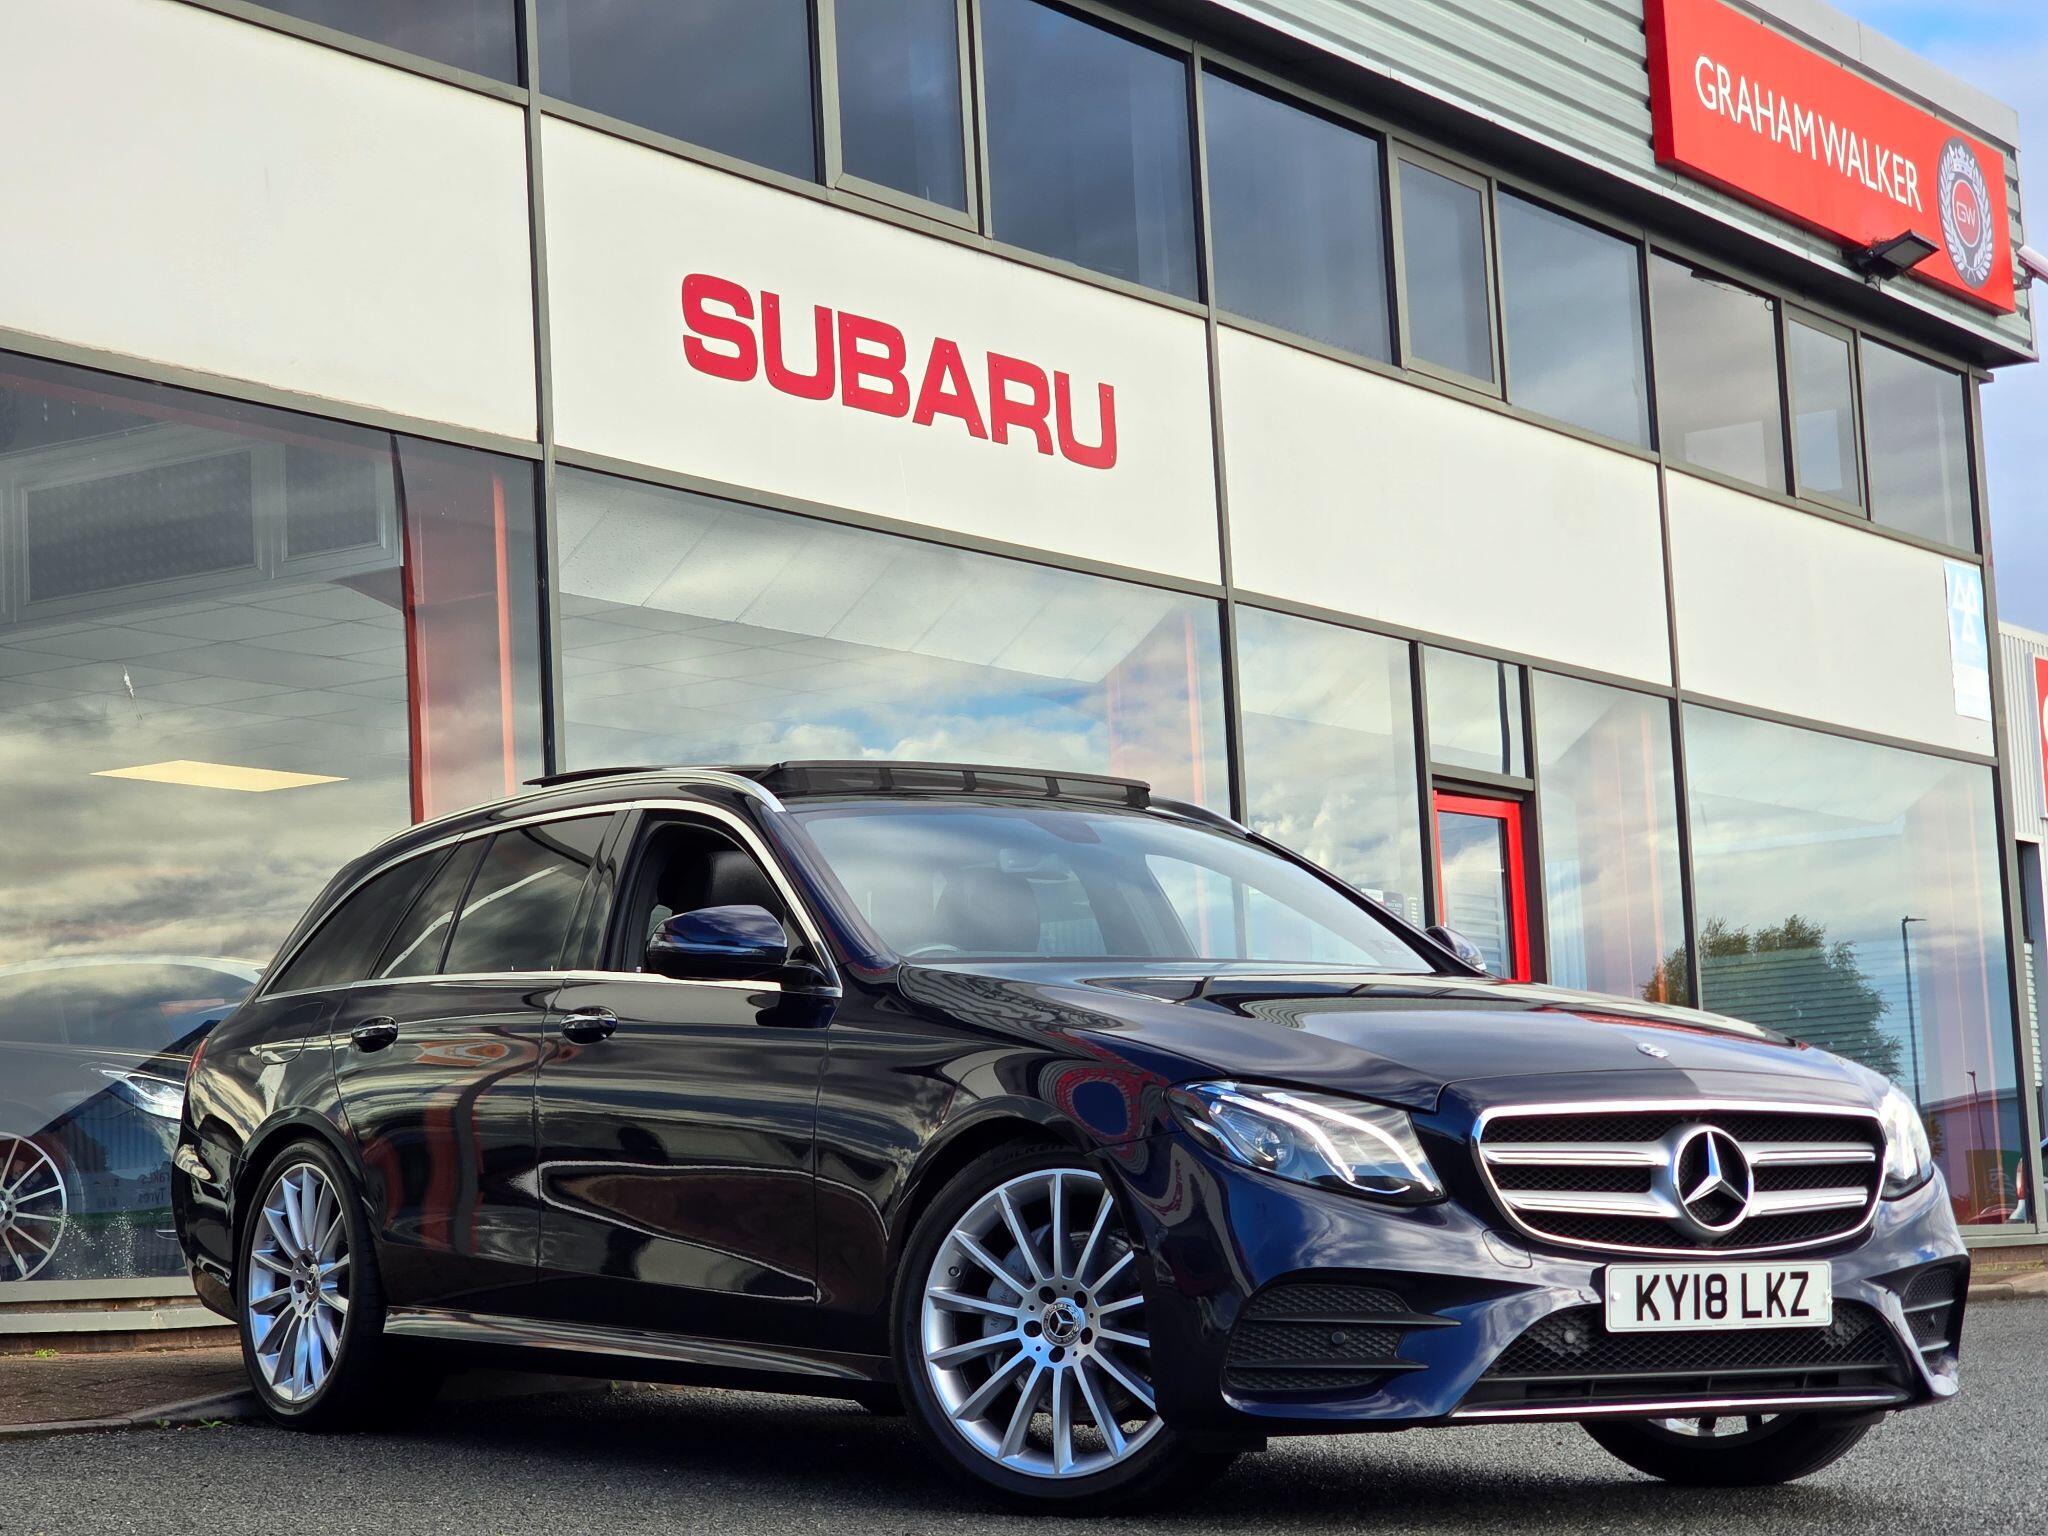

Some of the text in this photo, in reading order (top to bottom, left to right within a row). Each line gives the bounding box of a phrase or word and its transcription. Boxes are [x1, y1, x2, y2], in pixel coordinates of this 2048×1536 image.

[1694, 55, 1923, 213] GRAHAM WALKER
[1956, 200, 1976, 228] GW
[681, 273, 1118, 470] SUBARU
[1635, 1271, 1810, 1322] KY18 LKZ
